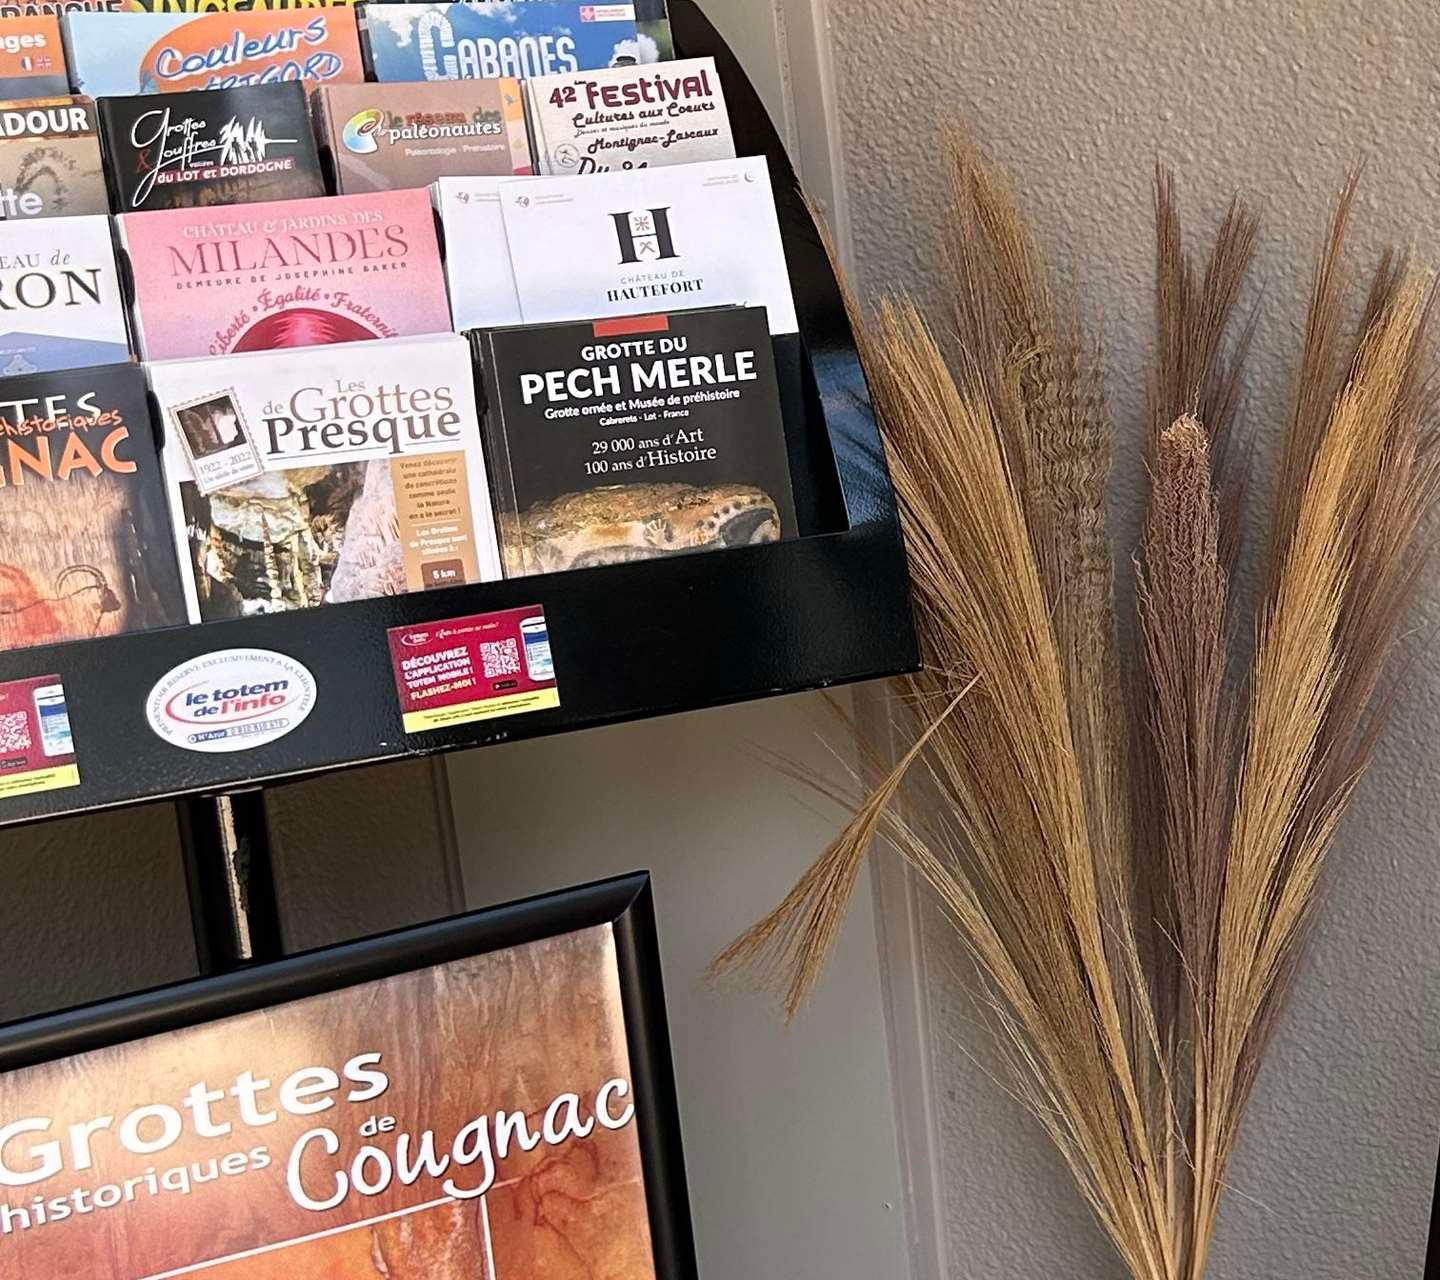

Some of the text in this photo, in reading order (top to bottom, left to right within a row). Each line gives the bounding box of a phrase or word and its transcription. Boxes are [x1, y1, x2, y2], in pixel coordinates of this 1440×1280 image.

[156, 17, 327, 78] Couleurs
[572, 101, 715, 128] Cultures aux Coeurs
[389, 121, 504, 144] paléonautes
[587, 128, 719, 154] Montignac-Lascaux
[157, 172, 174, 184] du
[176, 170, 200, 182] LOT
[203, 169, 217, 180] et
[220, 159, 293, 177] DORDOGNE
[282, 209, 383, 232] JARDINS DES
[51, 249, 72, 266] de
[167, 224, 409, 277] MILANDES
[176, 277, 241, 290] DEMEURE
[250, 275, 266, 284] DE
[363, 261, 408, 273] BAKER
[257, 284, 322, 311] Égalité
[607, 278, 704, 302] HAUTEFORT
[581, 336, 688, 362] GROTTE DU
[336, 380, 365, 393] Les
[520, 350, 758, 405] PECH MERLE
[262, 383, 454, 423] de Grottes
[544, 408, 580, 420] Grotte
[615, 400, 627, 412] et
[629, 396, 665, 410] Musée
[667, 394, 681, 406] de
[683, 388, 740, 406] préhistoire
[643, 412, 657, 421] Lot
[261, 410, 461, 455] Presque
[592, 428, 704, 455] 29 000 ans d'Art
[584, 446, 717, 475] 100 ans d'Histoire
[432, 568, 456, 579] 5 km
[402, 646, 468, 671] DÉCOUVREZ
[186, 680, 288, 706] le totem
[406, 670, 468, 690] TOTEM MOBILE
[410, 680, 472, 701] FLASHEZ-MOI
[194, 694, 286, 718] de l'info
[0, 1051, 389, 1188] Grottes
[286, 1077, 636, 1211] Cougnac
[0, 1113, 396, 1234] historiques de
